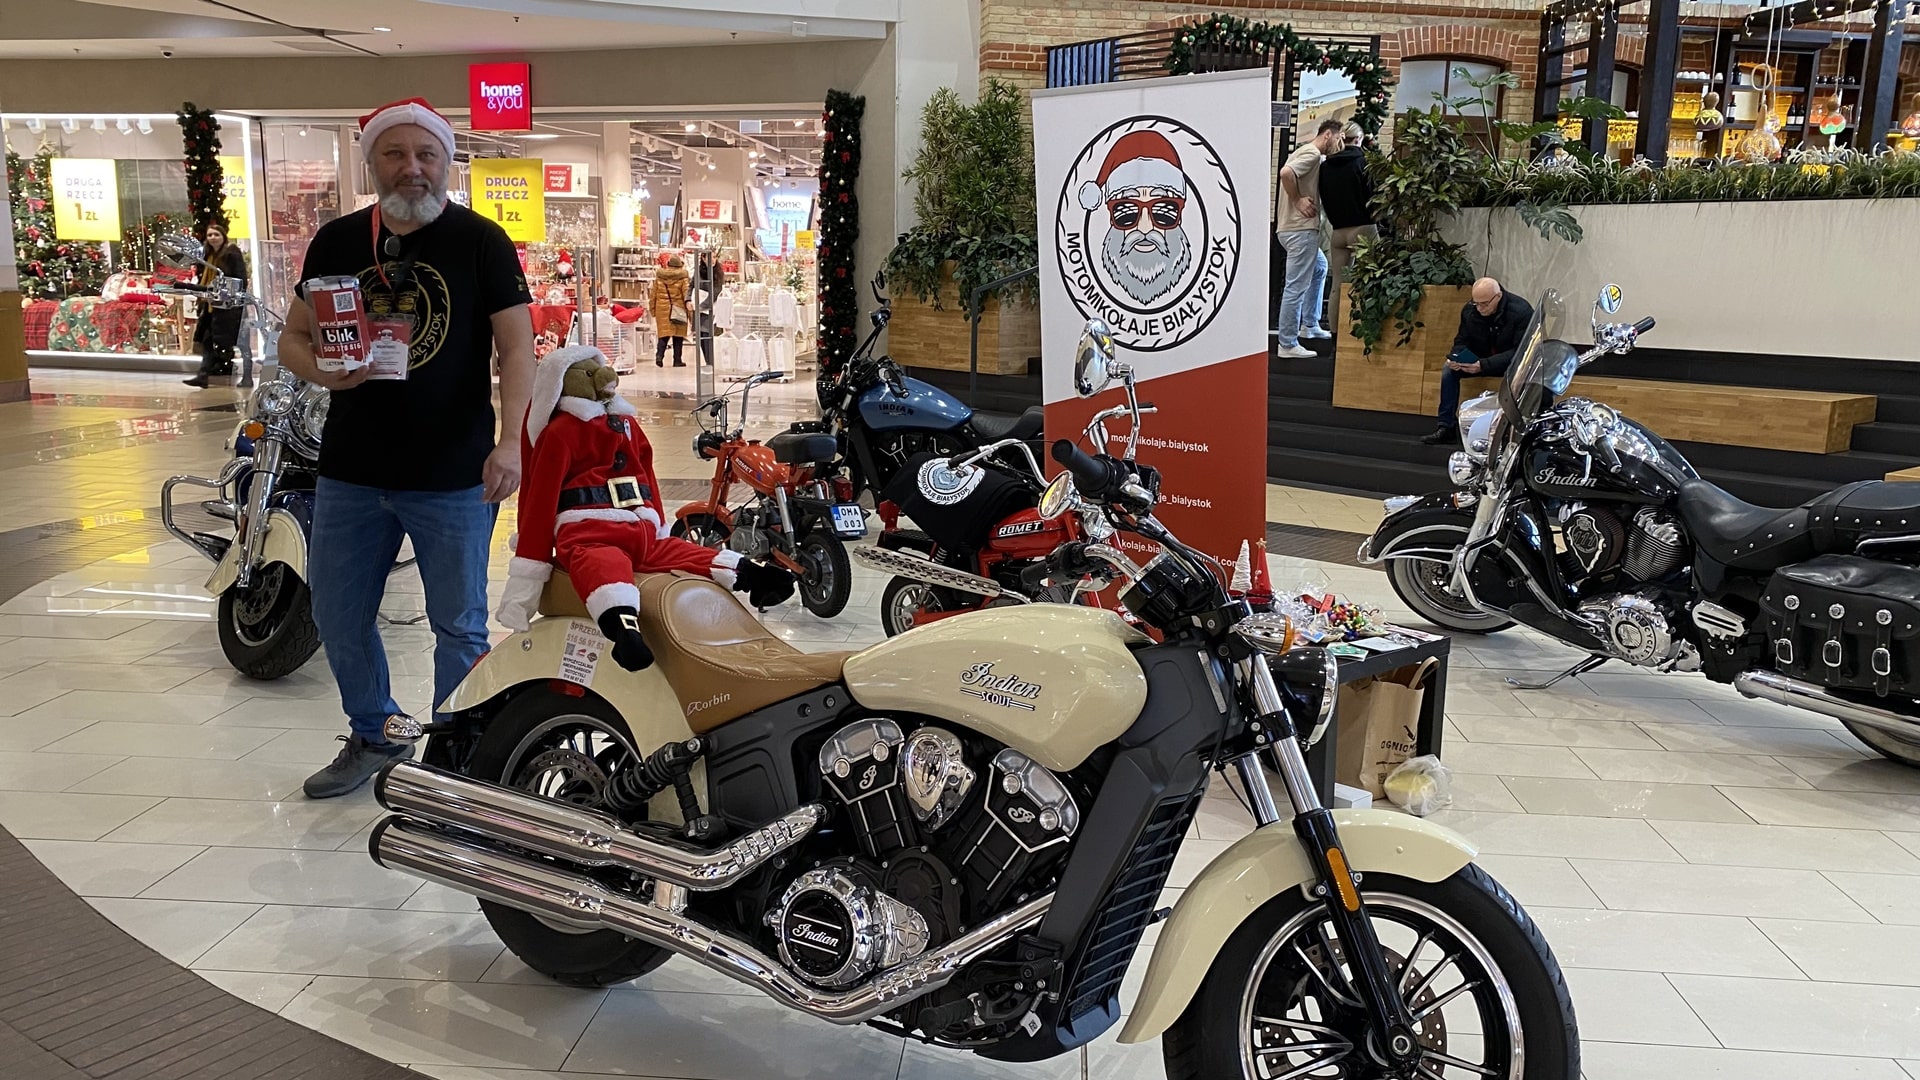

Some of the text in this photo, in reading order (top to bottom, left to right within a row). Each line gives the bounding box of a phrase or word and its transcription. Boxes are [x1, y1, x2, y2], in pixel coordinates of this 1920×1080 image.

[481, 82, 522, 97] home
[487, 96, 523, 114] &you
[65, 178, 103, 186] DRUGA
[223, 175, 245, 185] UGA
[485, 177, 528, 187] DRUGA
[66, 190, 104, 200] RZECZ
[486, 191, 529, 200] RZECZ
[772, 199, 801, 209] home
[1066, 232, 1228, 336] MOTOMIKOŁAJE BIAŁYSTOK
[326, 328, 354, 342] blik
[409, 312, 442, 360] IAŁYSTOK
[1111, 434, 1209, 452] motoikolaje.bialystok
[1534, 467, 1598, 487] Indian
[936, 487, 970, 502] BIAŁYSTOK
[998, 522, 1041, 536] ROMET
[960, 662, 1042, 699] Indian
[694, 693, 731, 712] Corbin
[981, 691, 1012, 707] SCOUT
[792, 923, 839, 947] Indian
